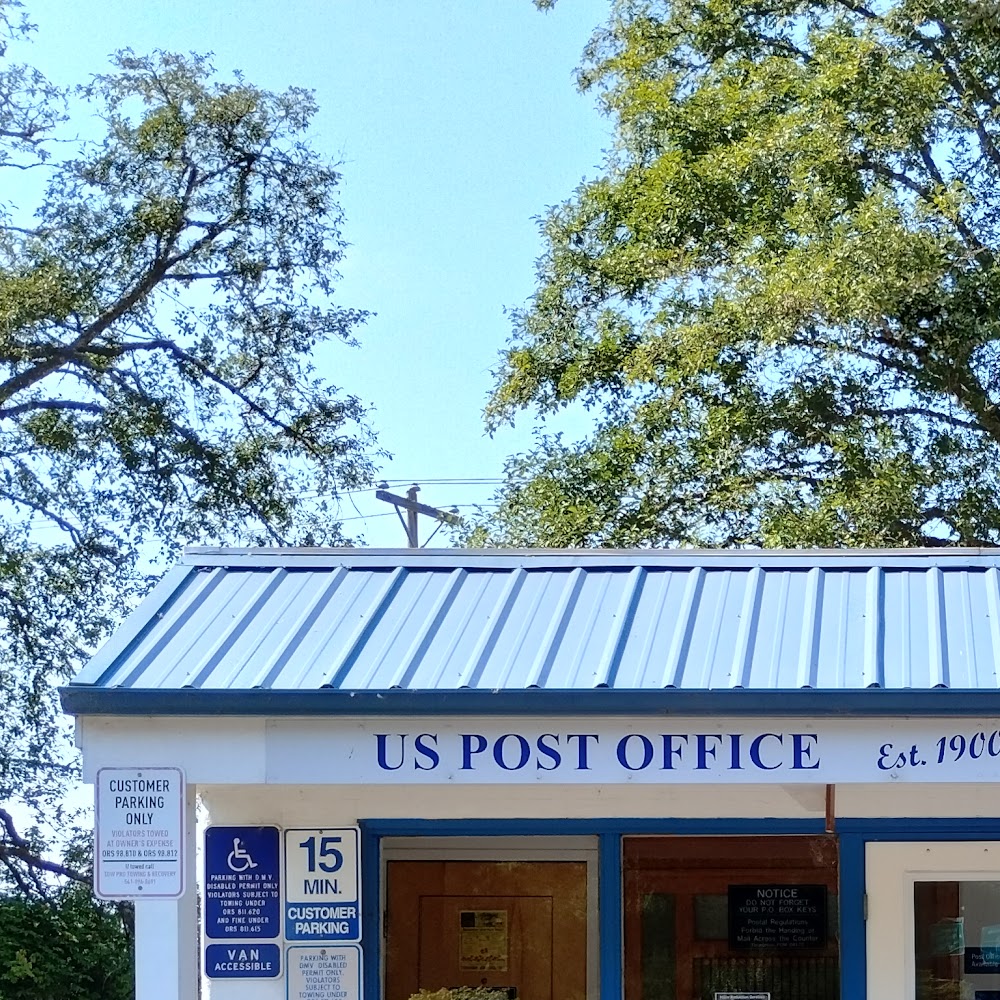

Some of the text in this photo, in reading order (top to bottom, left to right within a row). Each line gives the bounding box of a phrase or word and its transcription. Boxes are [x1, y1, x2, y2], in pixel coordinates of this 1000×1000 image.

[373, 732, 822, 772] US POST OFFICE
[877, 743, 927, 770] Est.
[109, 779, 170, 792] CUSTOMER
[115, 796, 164, 809] PARKING
[125, 812, 153, 825] ONLY
[111, 829, 169, 838] VIOLATORS TOWED
[106, 840, 114, 848] AT
[115, 840, 145, 848] OWNER'S
[299, 836, 343, 873] 15
[304, 879, 342, 895] MIN.
[756, 888, 799, 899] NOTICE
[287, 907, 357, 920] CUSTOMER
[295, 921, 349, 935] PARKING
[770, 918, 809, 926] Regulations
[227, 949, 259, 961] VAN
[214, 962, 272, 971] ACCESSIBLE
